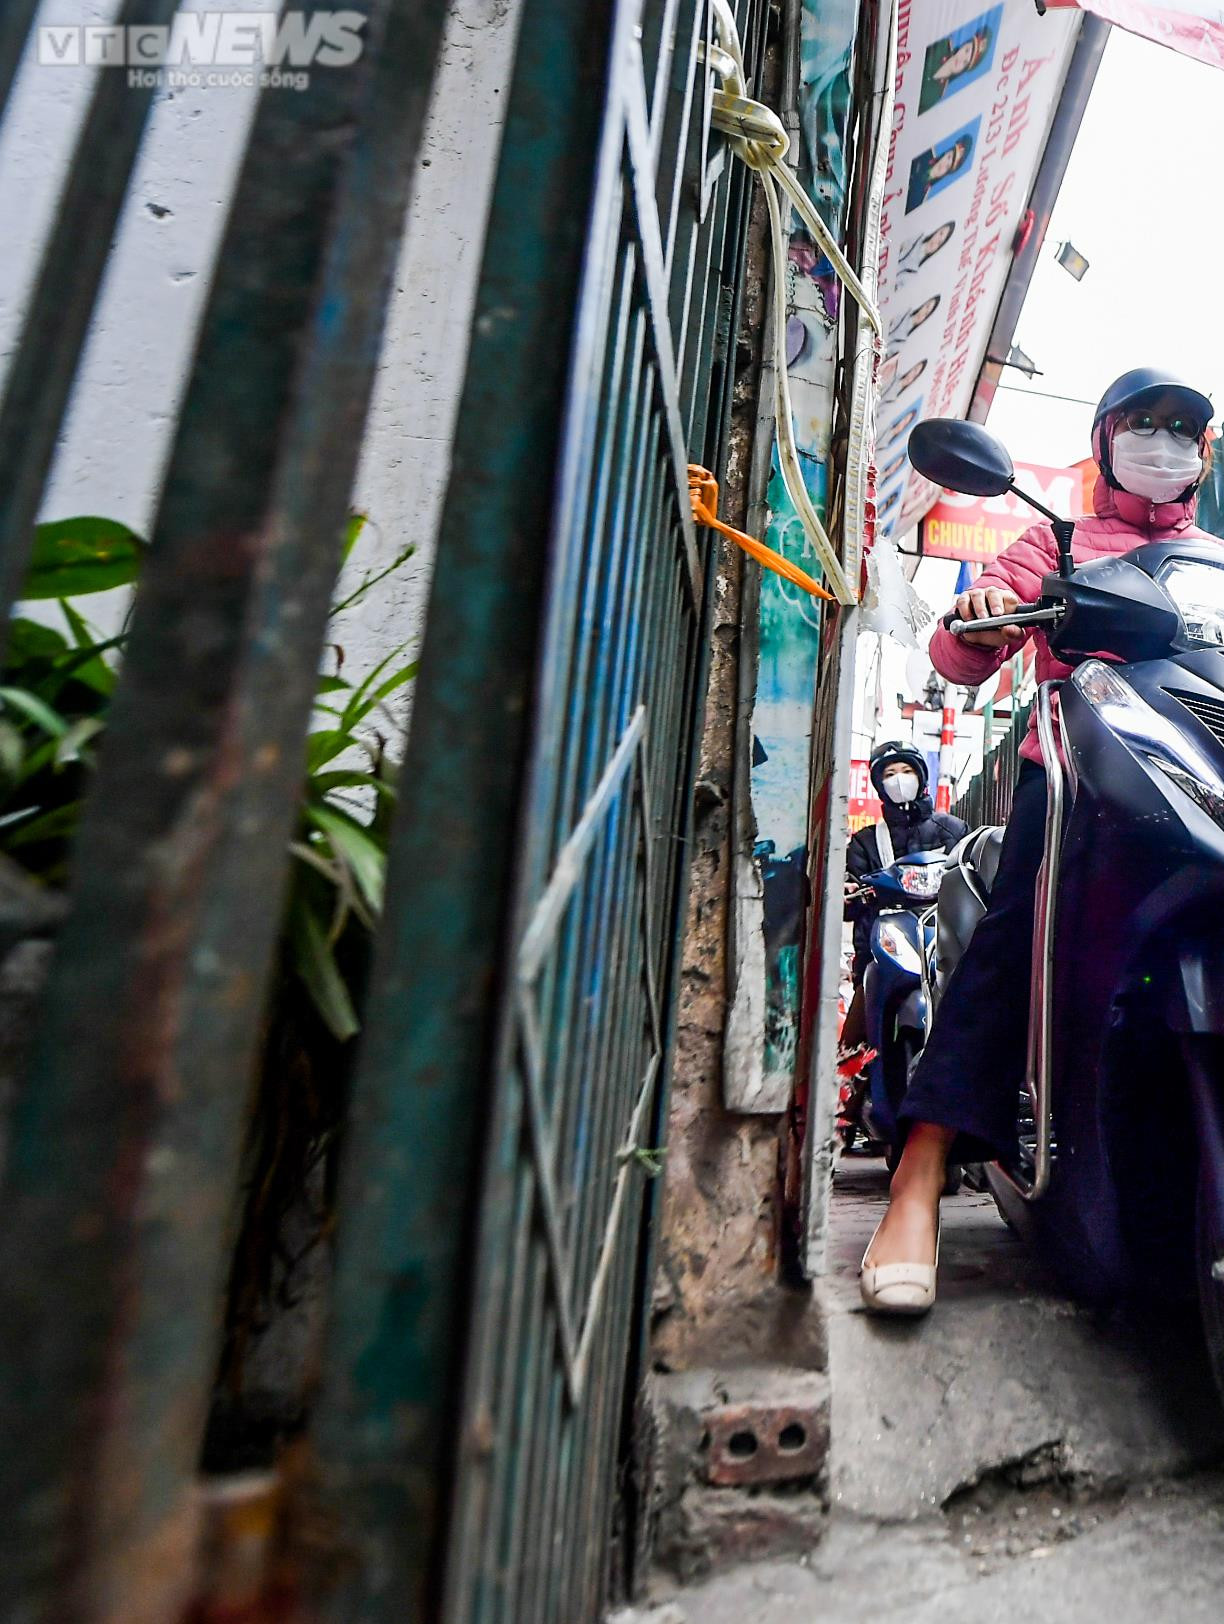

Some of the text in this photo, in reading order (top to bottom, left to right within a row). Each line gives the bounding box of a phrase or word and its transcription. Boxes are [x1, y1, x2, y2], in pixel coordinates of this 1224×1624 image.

[985, 96, 1009, 145] 213
[1001, 48, 1056, 159] Ảnh
[985, 171, 1016, 226] Số
